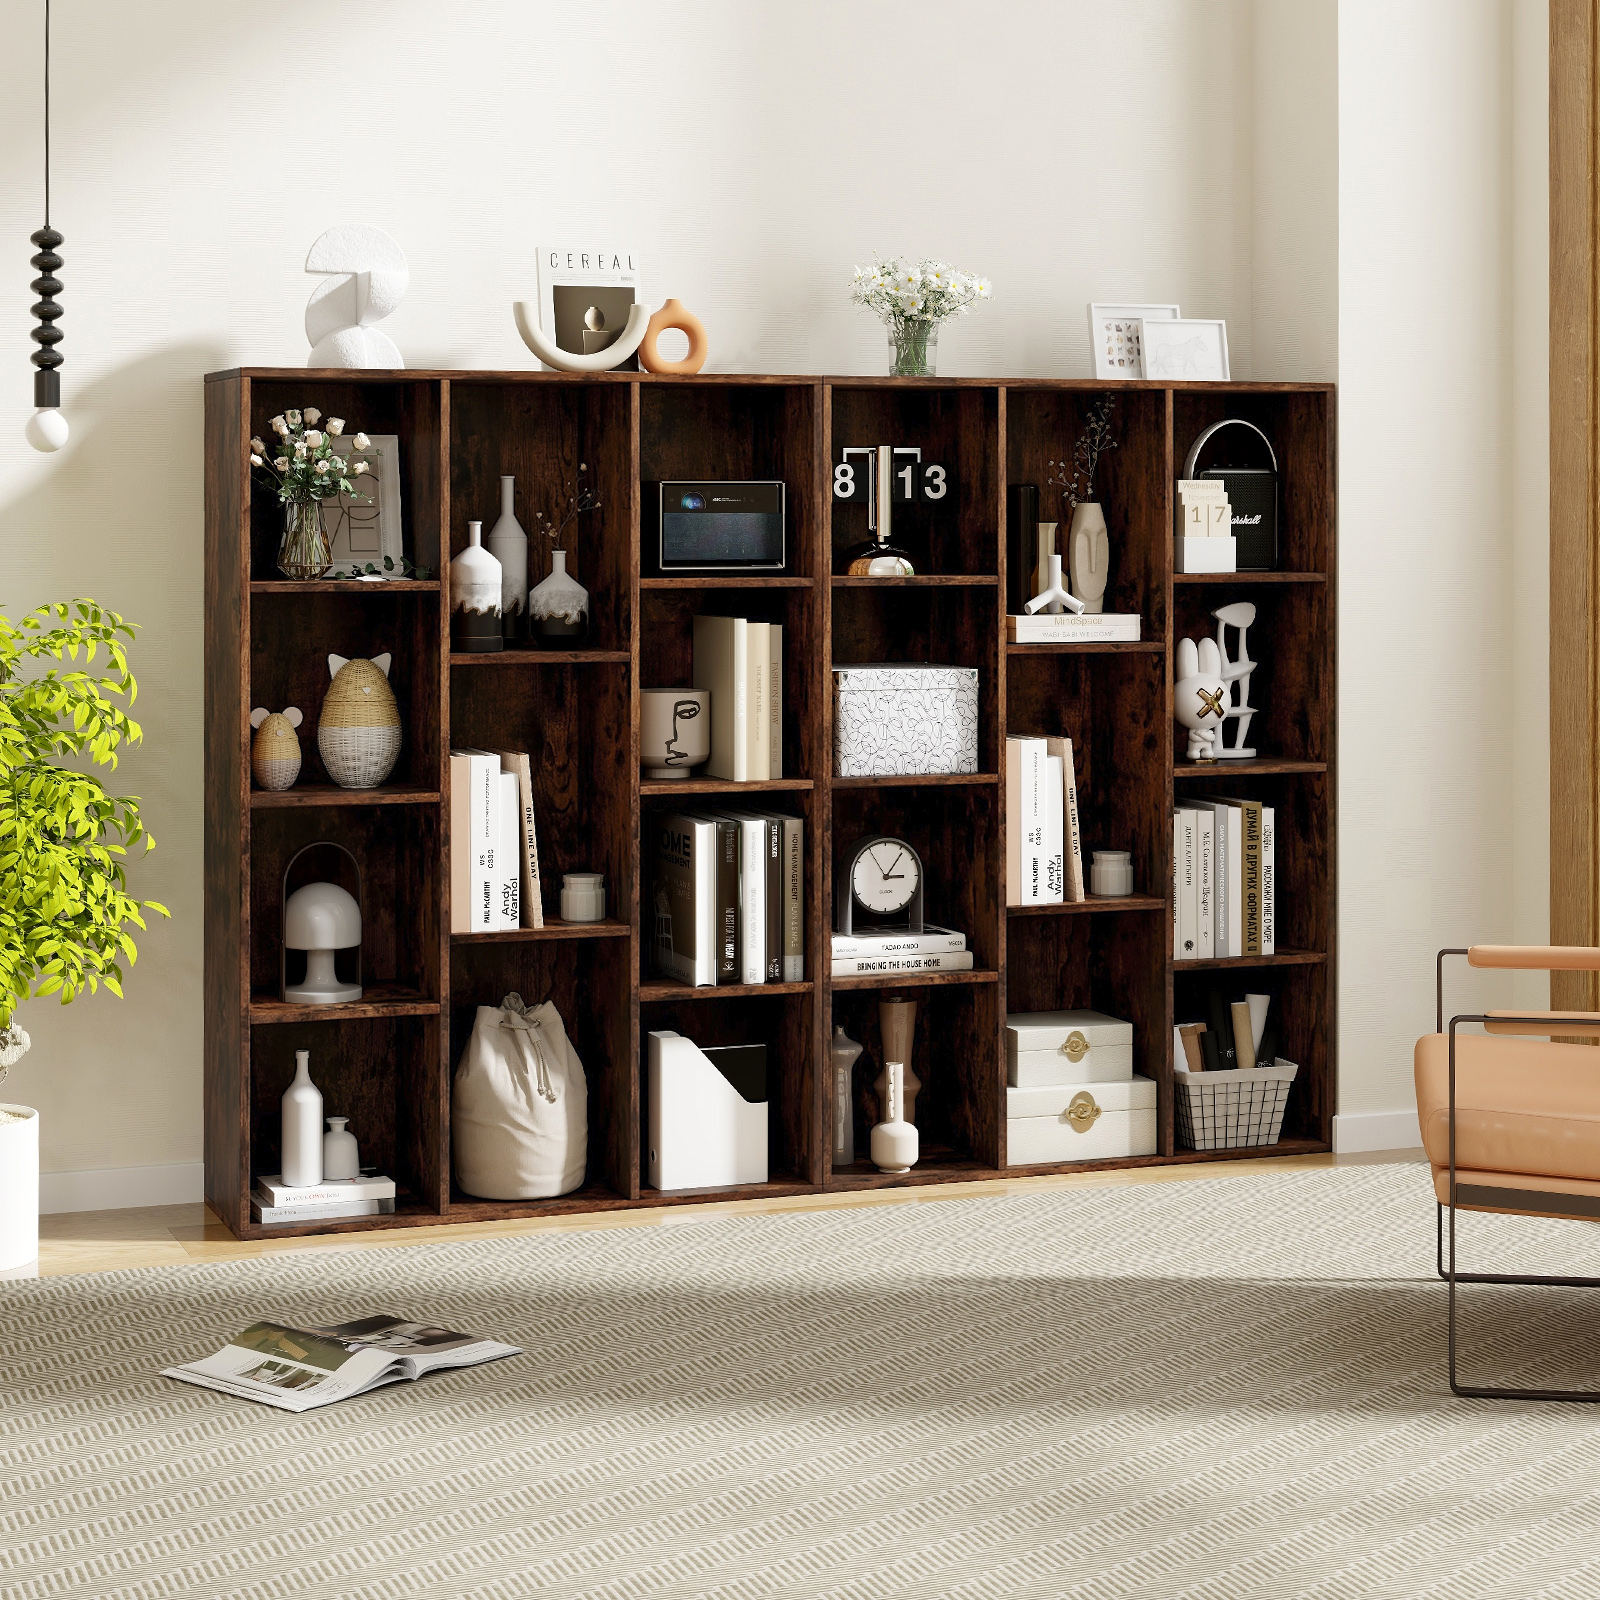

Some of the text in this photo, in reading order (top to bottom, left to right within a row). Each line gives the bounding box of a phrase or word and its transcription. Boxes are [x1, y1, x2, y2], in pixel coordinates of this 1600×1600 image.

[550, 252, 636, 270] CEREAL
[833, 463, 855, 498] 8
[1183, 482, 1220, 490] Wednesday
[1231, 513, 1261, 525] arshall
[1054, 617, 1103, 626] MindSpace
[1246, 808, 1259, 841] ДУМАЙ
[660, 829, 690, 857] OME
[1047, 860, 1056, 890] Andy
[1246, 853, 1257, 890] ДРУГИХ
[1264, 865, 1272, 900] РАССКАЖИ
[501, 884, 511, 916] Andy
[1264, 902, 1272, 917] МНЕ
[1247, 893, 1257, 943] ФОРМАТАХ
[1264, 925, 1272, 943] МОРЕ
[857, 959, 940, 971] BRINGING THE HOUSE HOME
